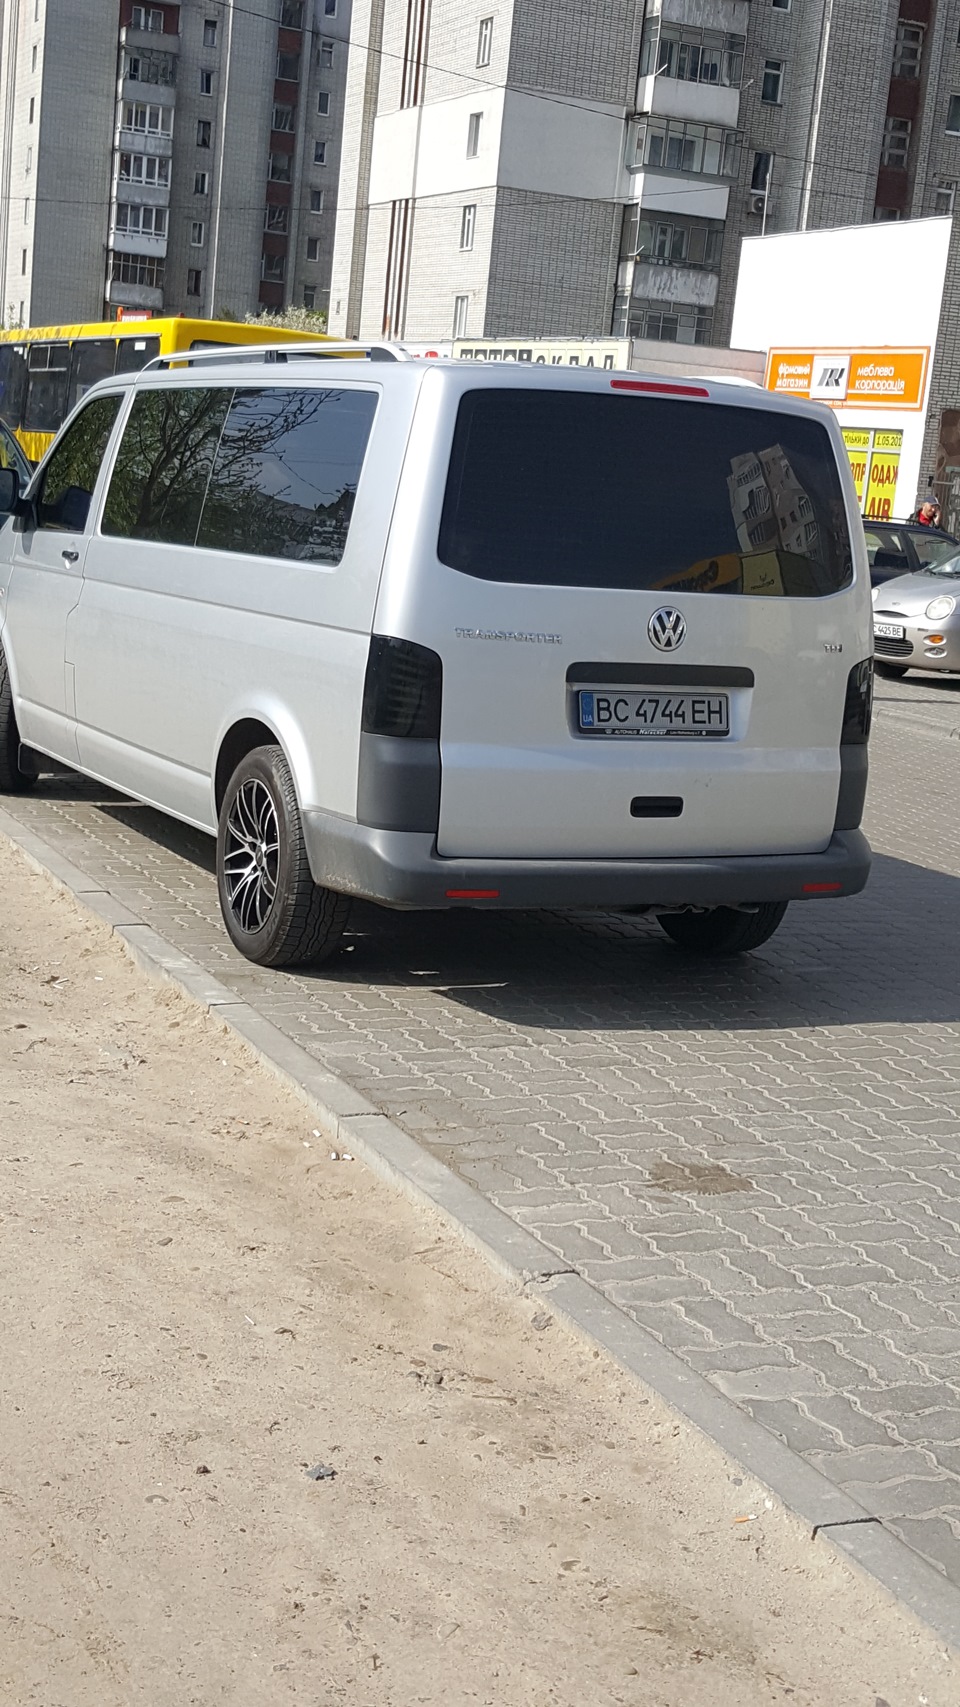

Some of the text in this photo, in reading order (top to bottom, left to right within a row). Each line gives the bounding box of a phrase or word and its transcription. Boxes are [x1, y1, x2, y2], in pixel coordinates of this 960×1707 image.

[857, 363, 895, 376] меблева
[776, 377, 809, 387] магазин
[854, 378, 905, 394] корпорація
[876, 436, 902, 447] 1.05.201
[455, 627, 563, 644] TRANSPORTER
[892, 627, 901, 636] BE
[596, 698, 723, 724] BC 4744 EH
[583, 714, 593, 722] UA
